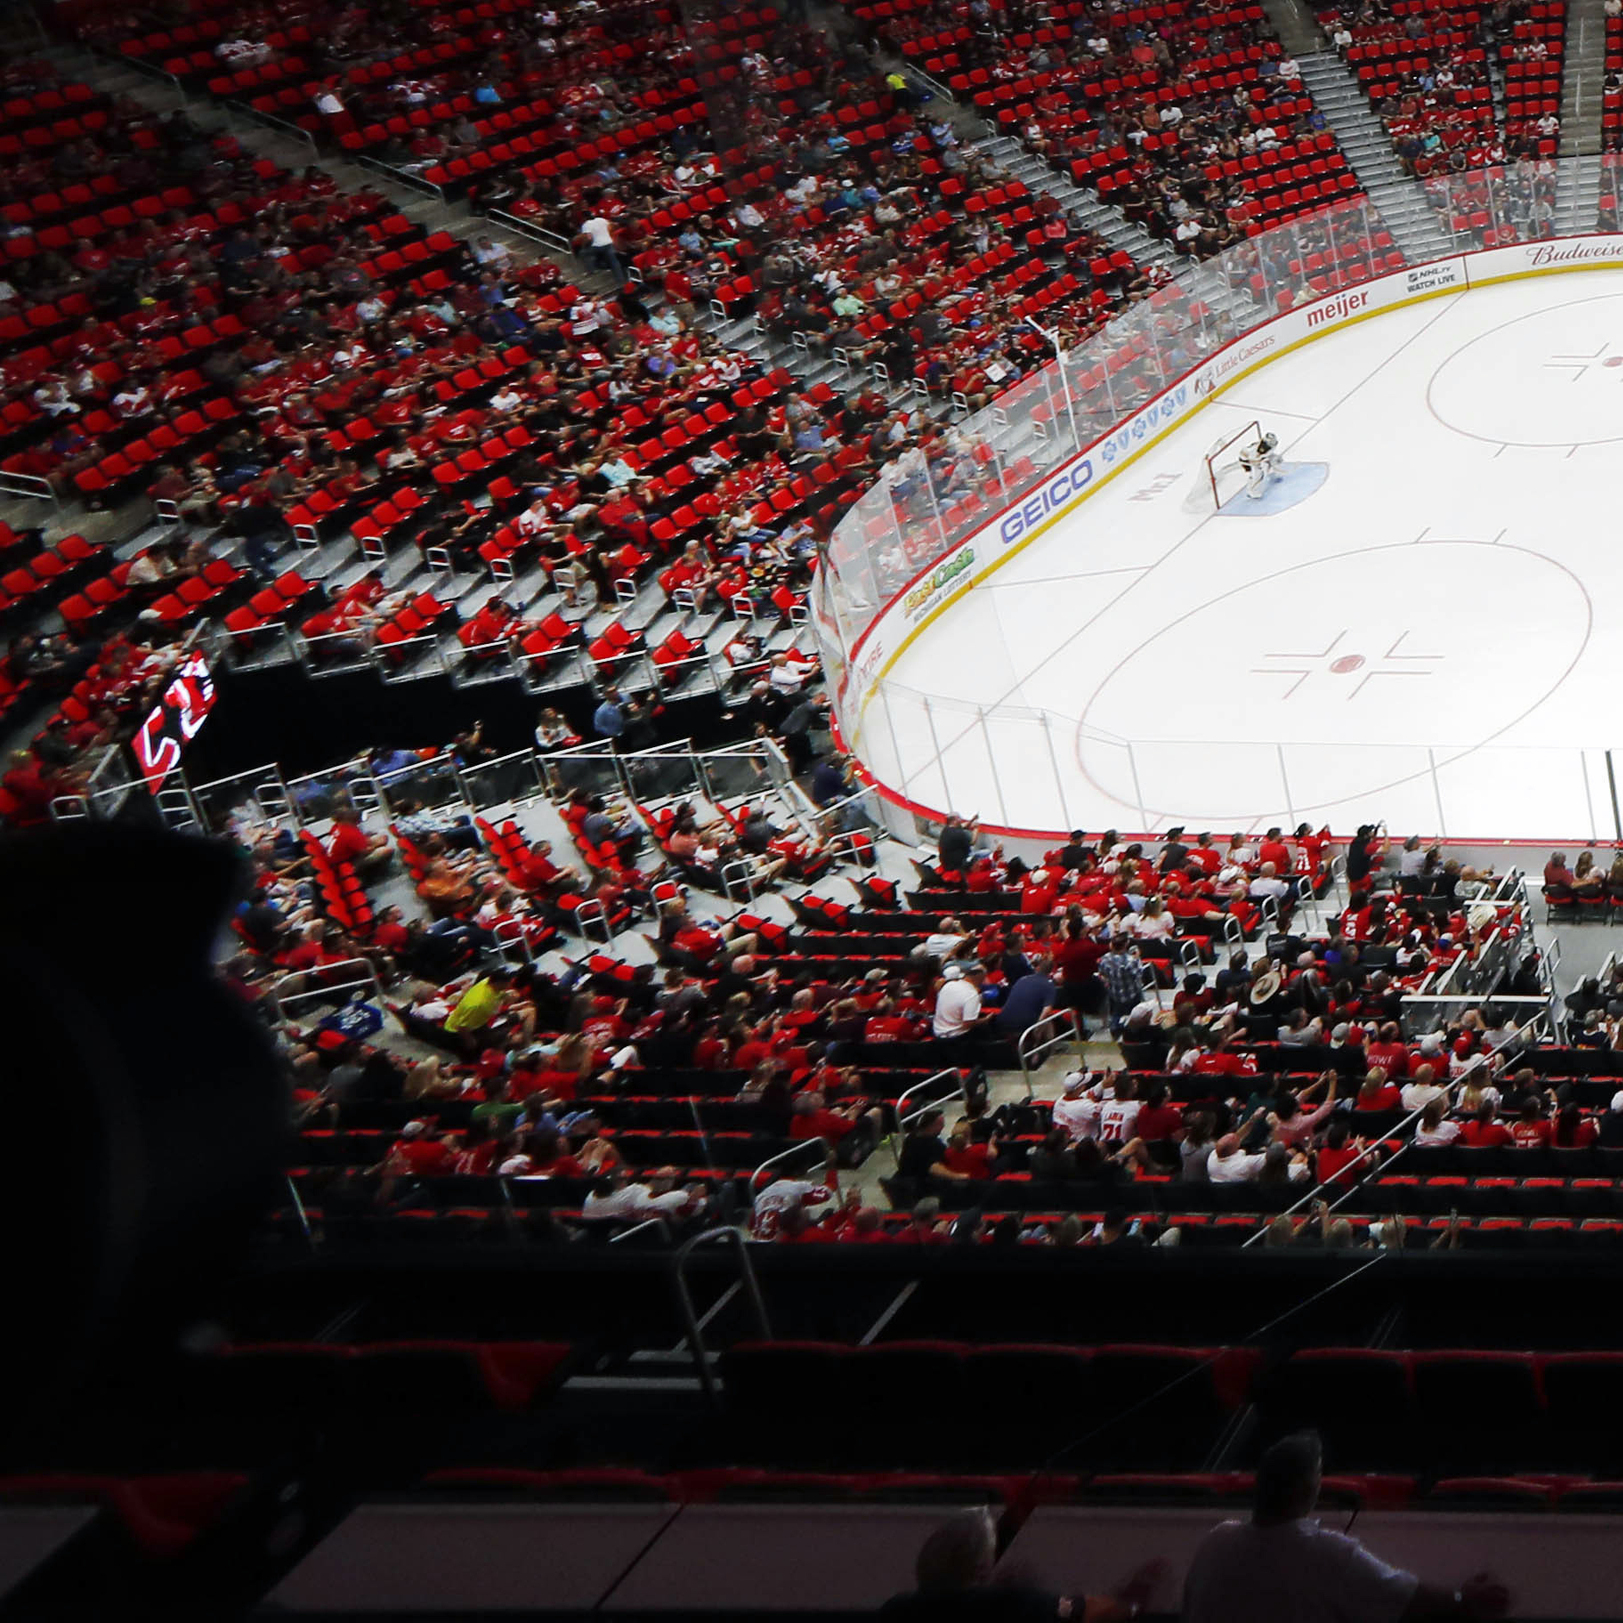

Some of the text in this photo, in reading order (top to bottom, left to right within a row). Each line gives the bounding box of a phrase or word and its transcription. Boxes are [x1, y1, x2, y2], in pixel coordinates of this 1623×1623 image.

[1407, 274, 1456, 293] WATCH LIVE
[1306, 291, 1369, 327] meijer
[1215, 334, 1276, 378] Little Caesars
[1000, 459, 1094, 545] GEICO
[1103, 1124, 1123, 1140] 71
